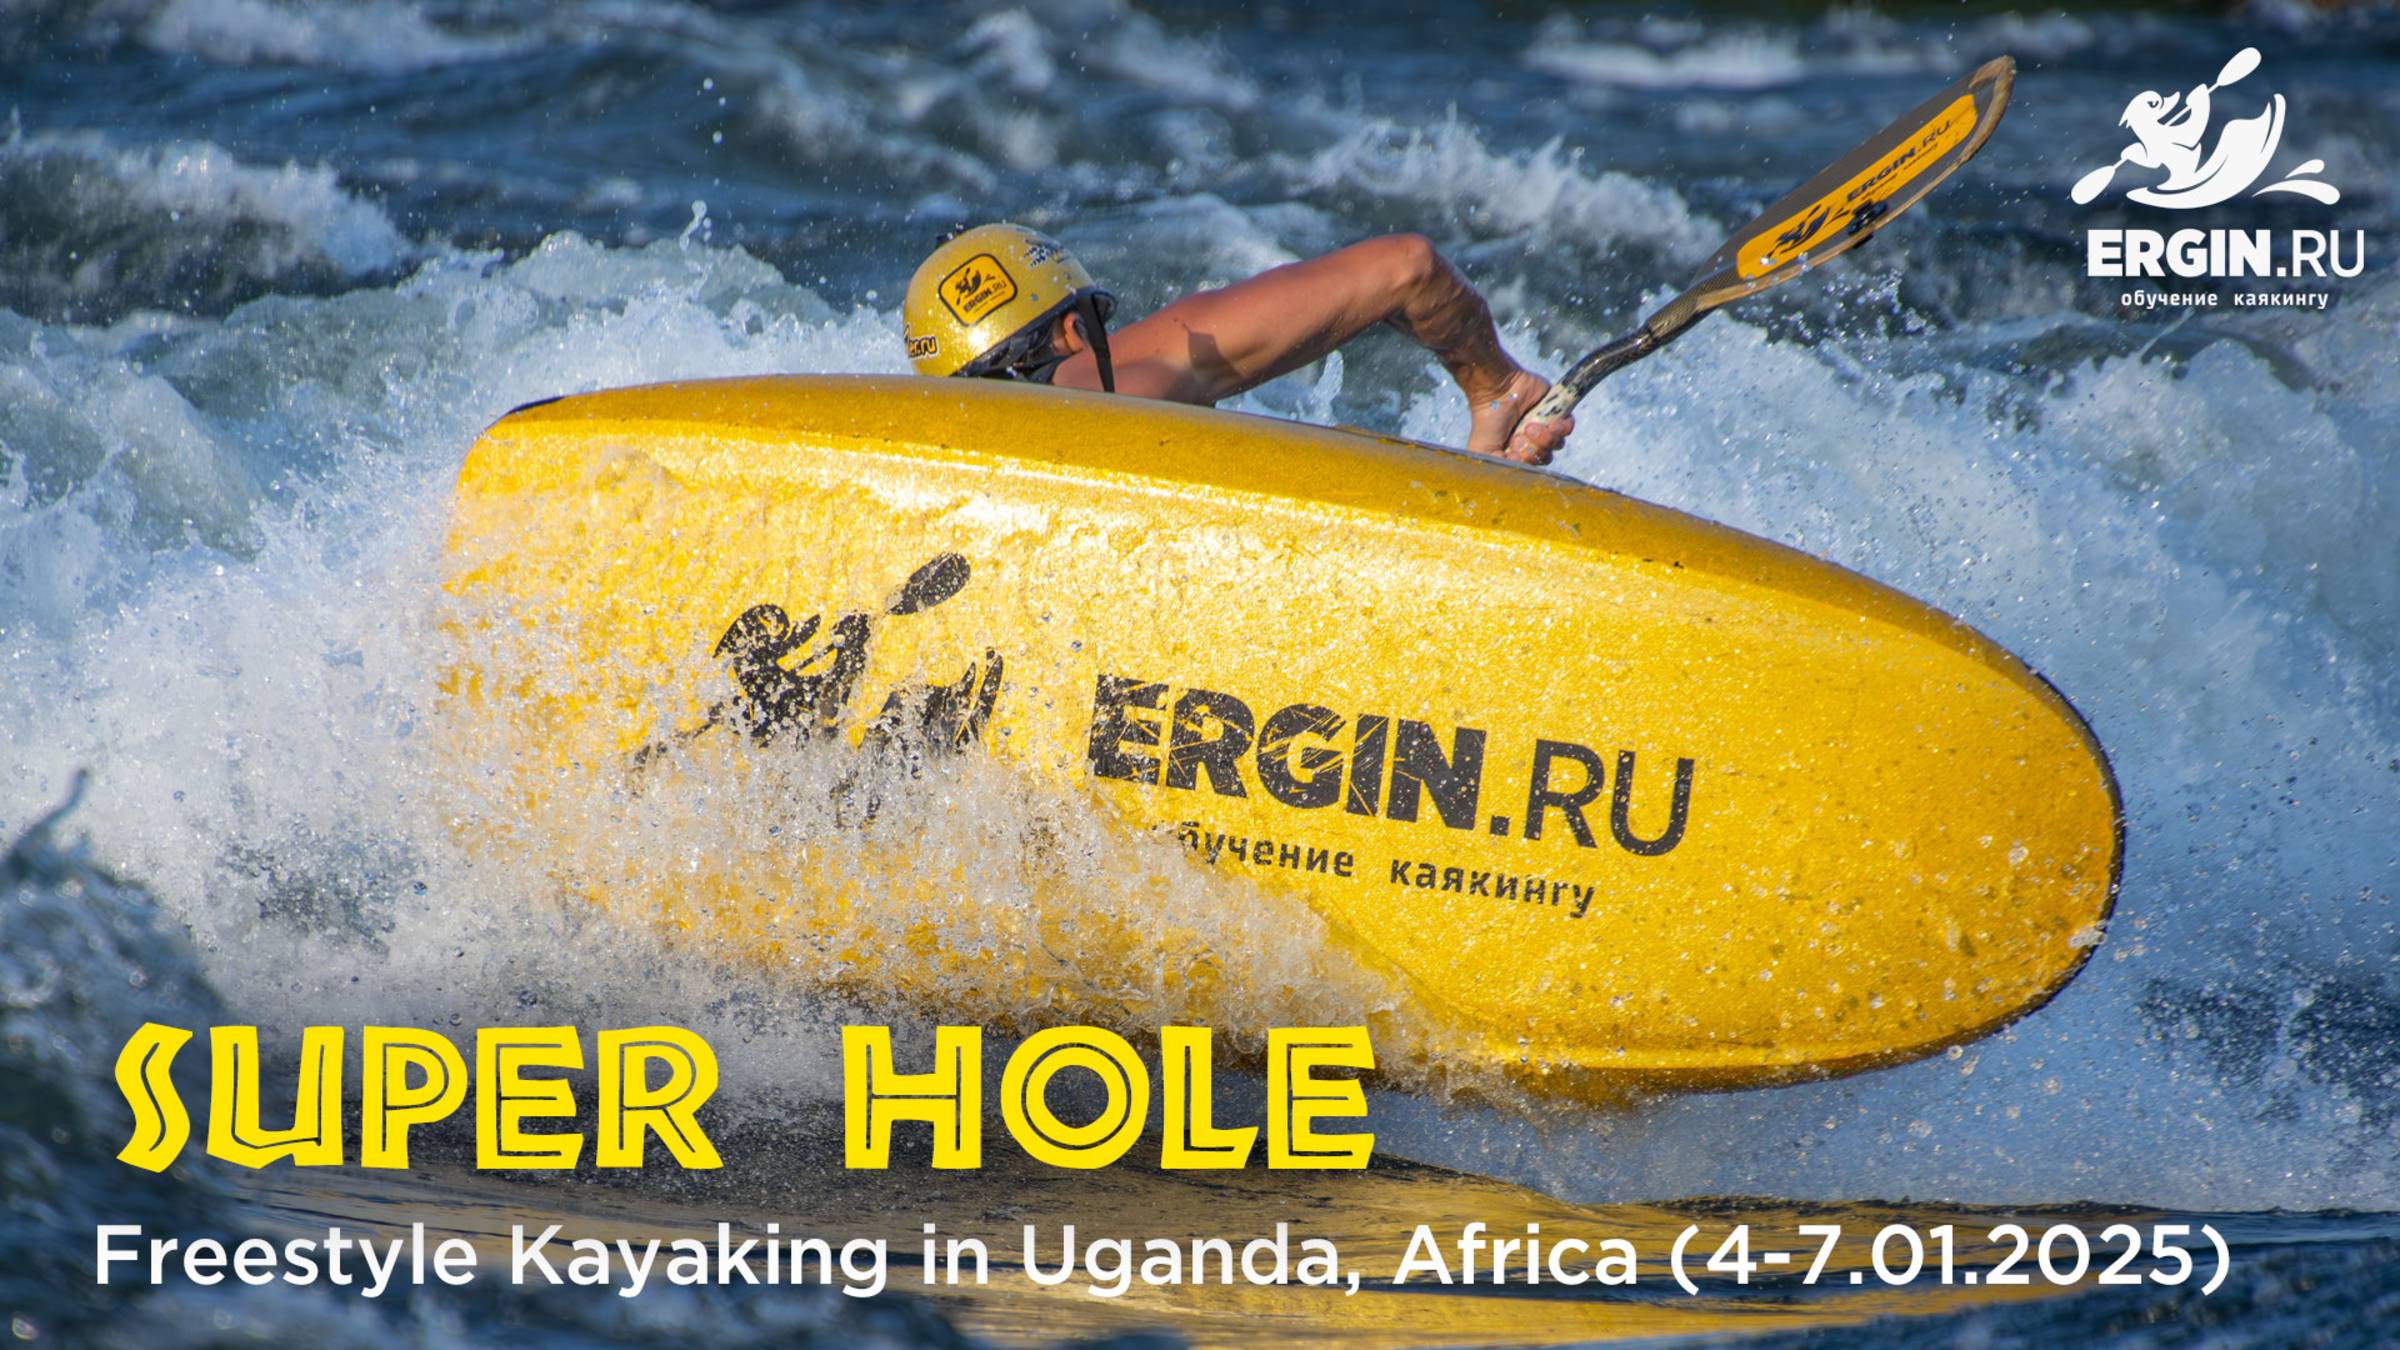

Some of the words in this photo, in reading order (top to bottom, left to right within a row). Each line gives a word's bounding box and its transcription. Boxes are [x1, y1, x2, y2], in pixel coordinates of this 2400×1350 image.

[1847, 119, 1951, 202] ERGIN.RU
[1087, 673, 1696, 857] ERGIN.RU
[1152, 819, 1355, 878] бучение
[1390, 854, 1596, 919] каякингу
